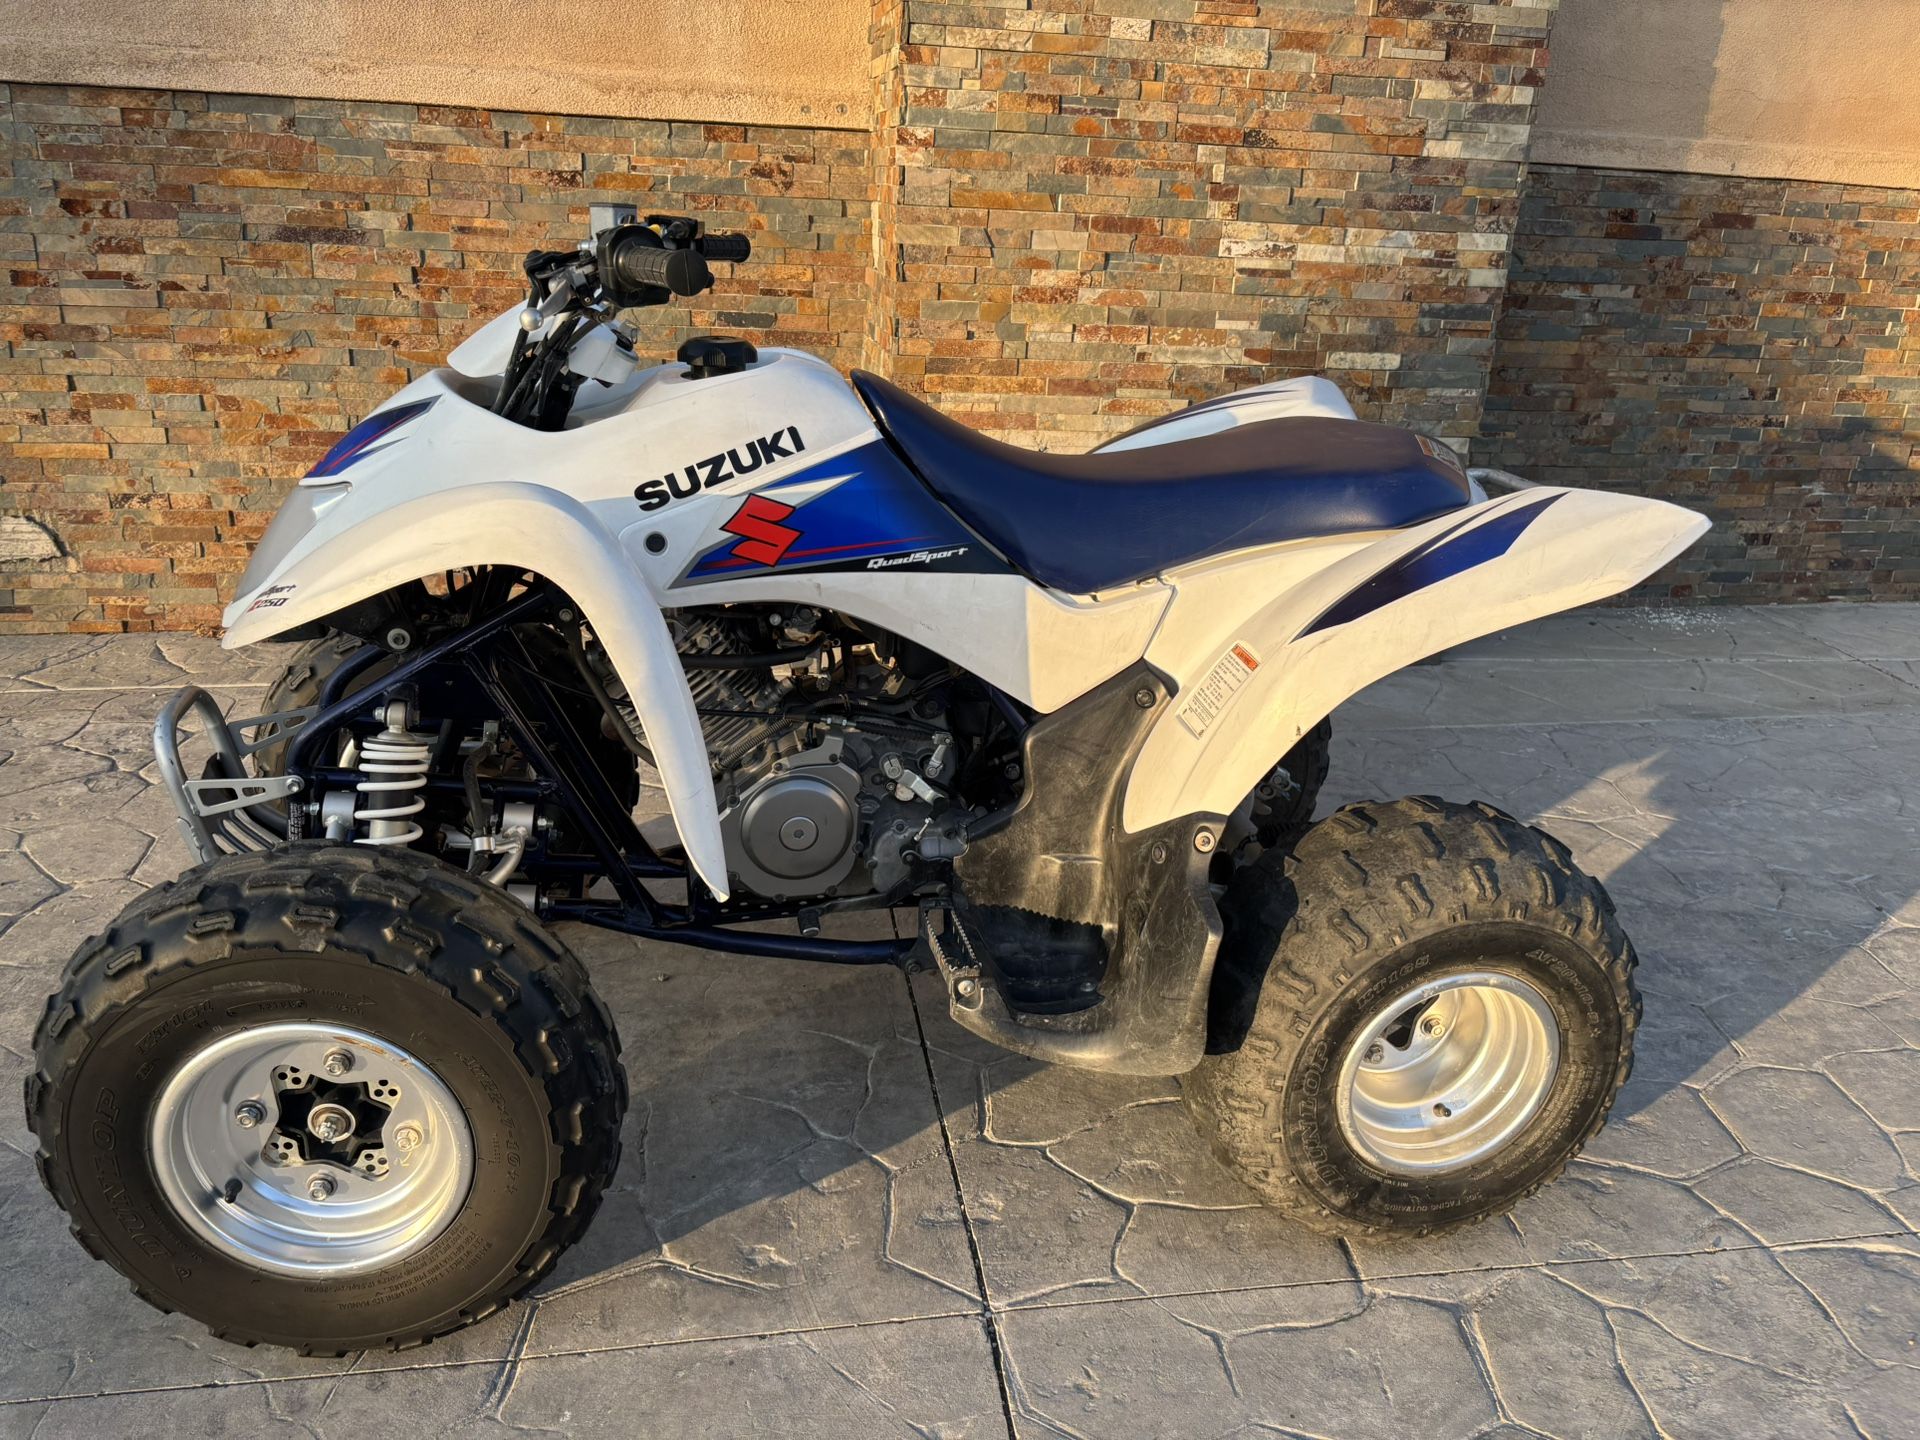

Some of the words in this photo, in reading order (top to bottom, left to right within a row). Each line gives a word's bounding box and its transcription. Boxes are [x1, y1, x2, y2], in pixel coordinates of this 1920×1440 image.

[634, 426, 805, 511] SUZUKI
[867, 546, 968, 568] QuadSport
[1299, 1040, 1344, 1187] DUNLOP
[92, 1088, 170, 1260] DUNLOP
[1430, 1198, 1461, 1212] FACING
